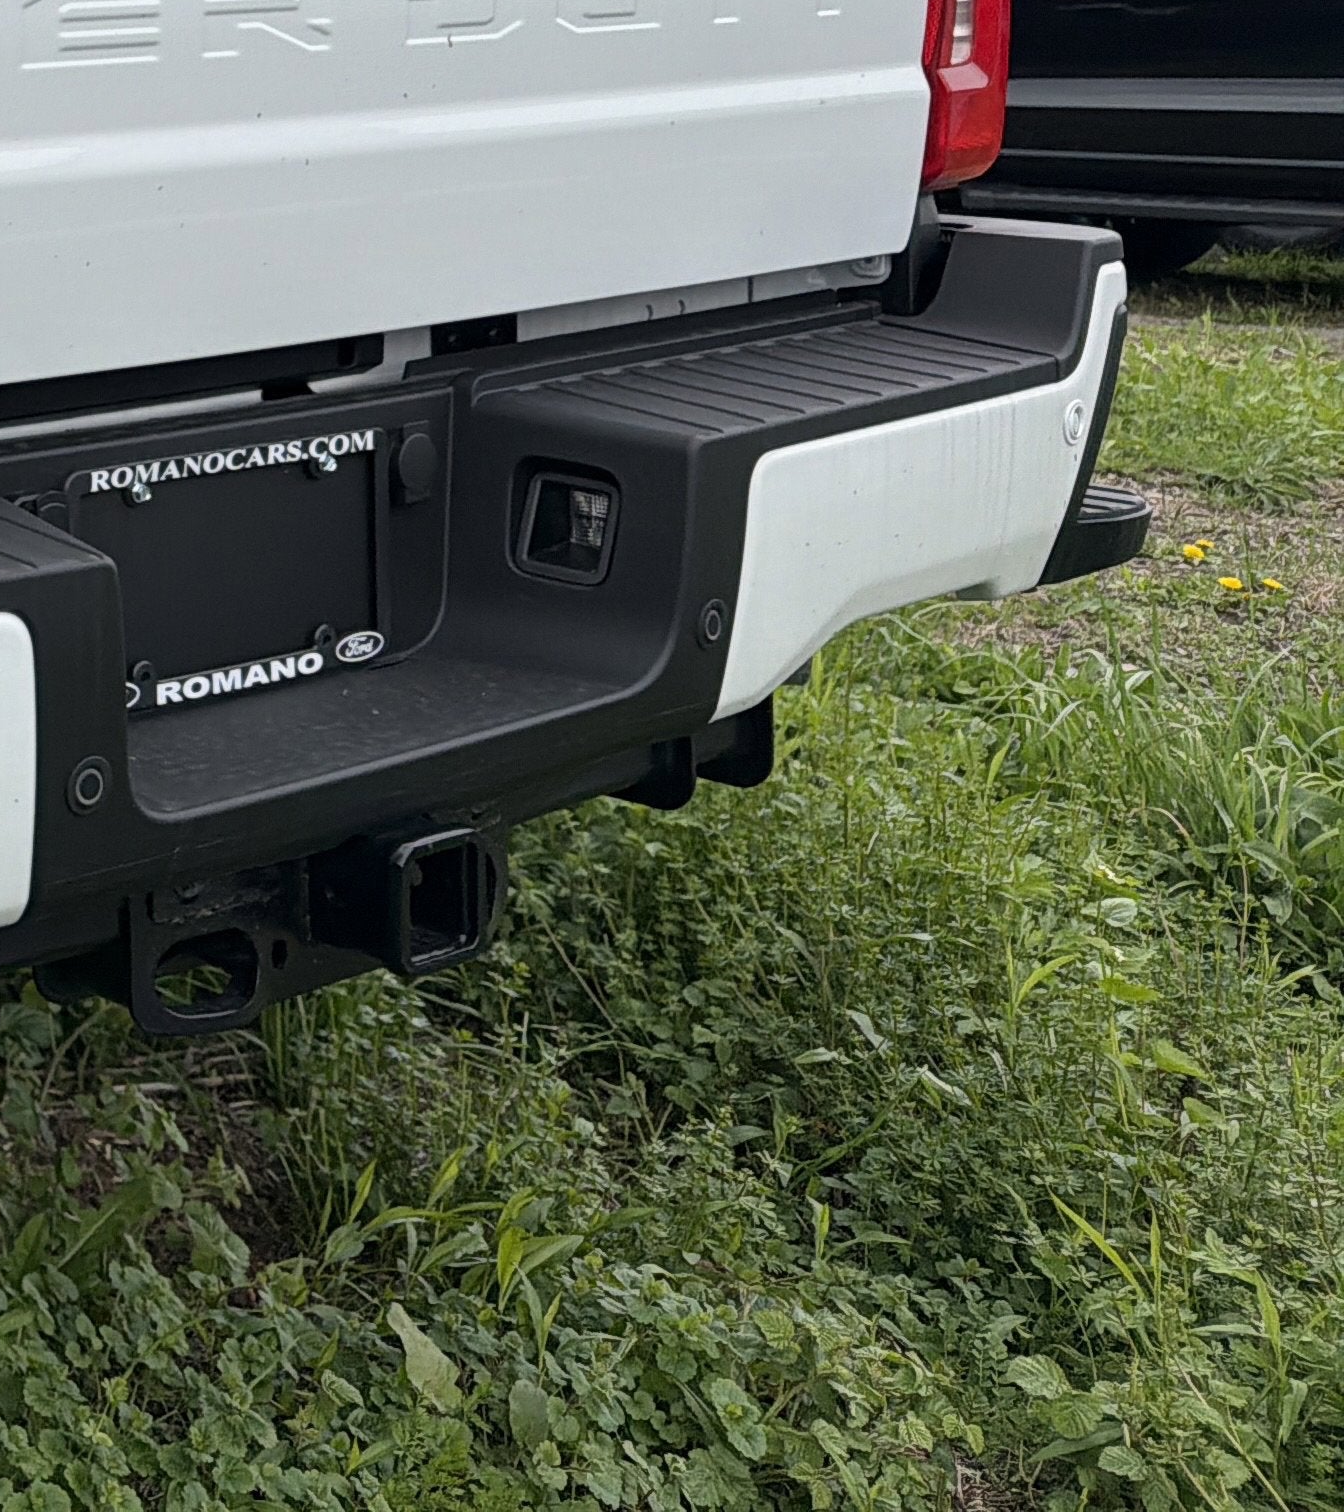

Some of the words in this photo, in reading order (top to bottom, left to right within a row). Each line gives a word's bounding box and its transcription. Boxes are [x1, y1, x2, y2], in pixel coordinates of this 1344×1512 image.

[89, 430, 374, 493] ROMANOCARS.COM
[156, 652, 323, 706] ROMANO
[345, 636, 375, 657] Ford
